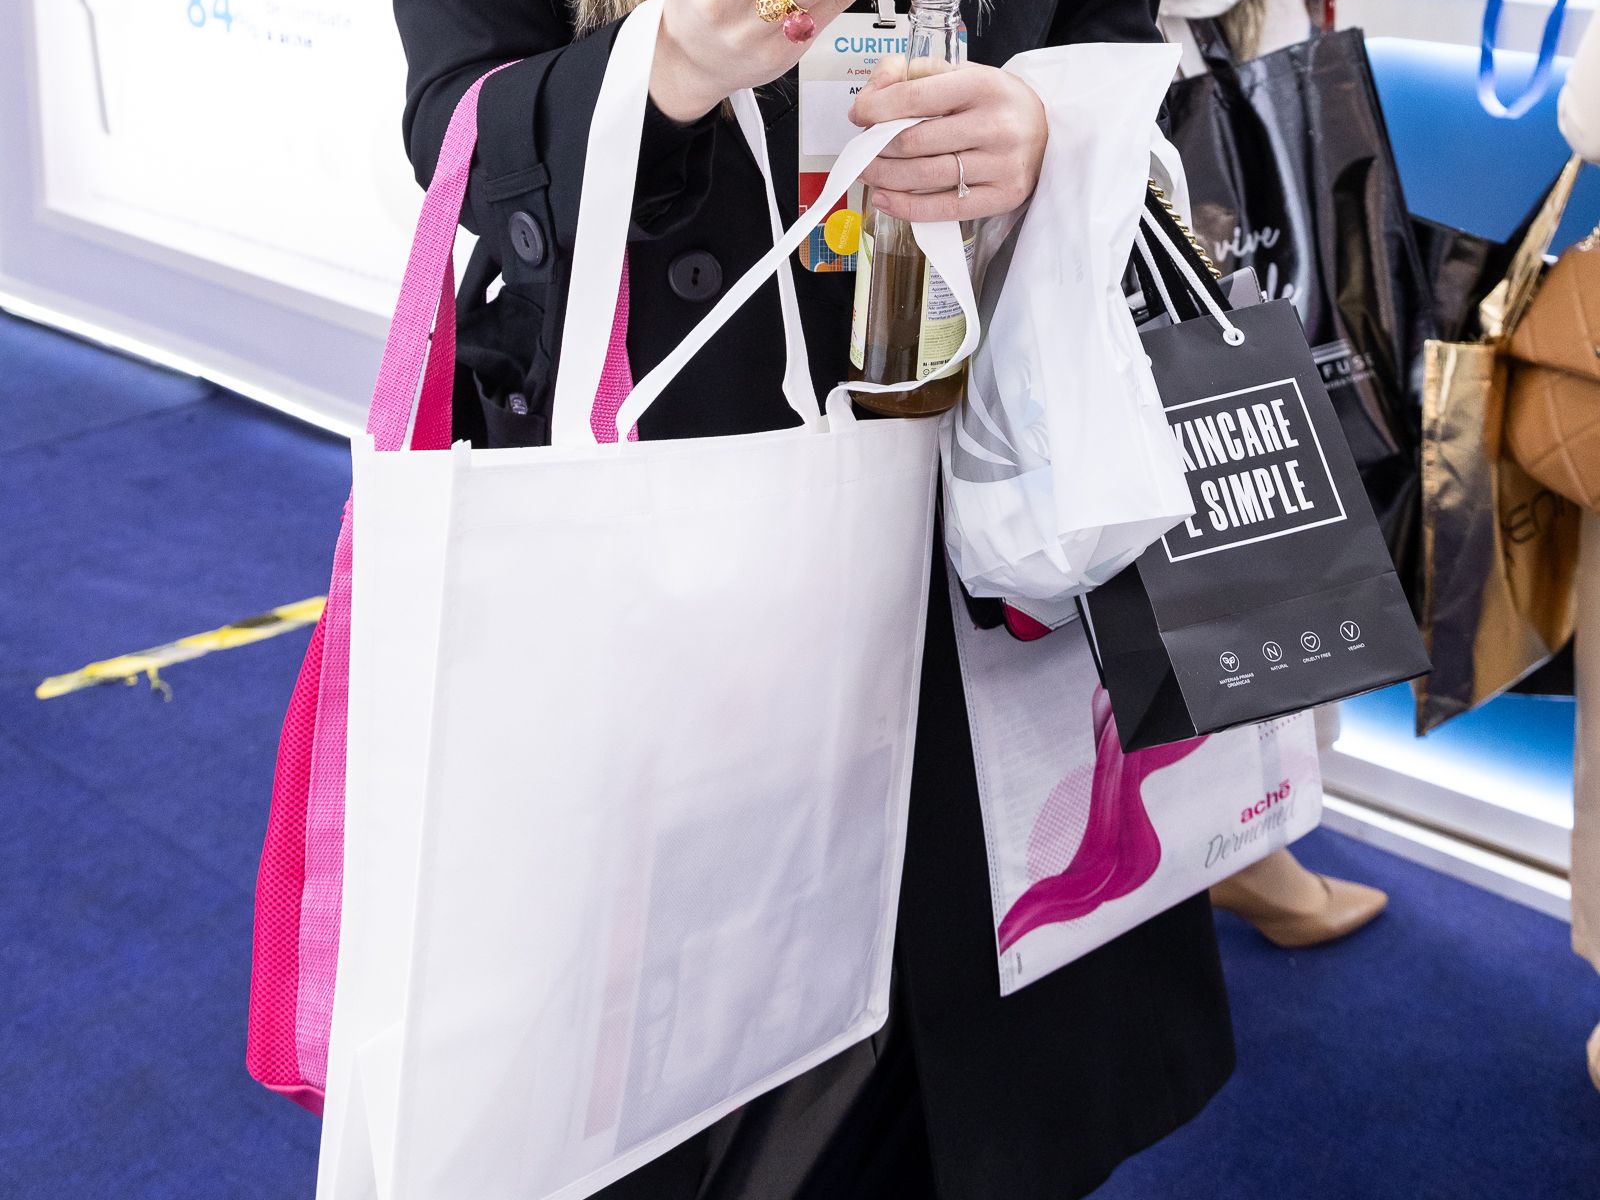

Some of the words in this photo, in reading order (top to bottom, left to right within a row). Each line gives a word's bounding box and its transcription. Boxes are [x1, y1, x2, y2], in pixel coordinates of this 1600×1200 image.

[854, 68, 872, 76] pele
[1200, 459, 1315, 532] SIMPLE
[1347, 642, 1366, 652] VEGANO
[1302, 654, 1321, 664] CRUELTY
[1320, 651, 1332, 661] FREE
[1270, 663, 1289, 672] NATURAL
